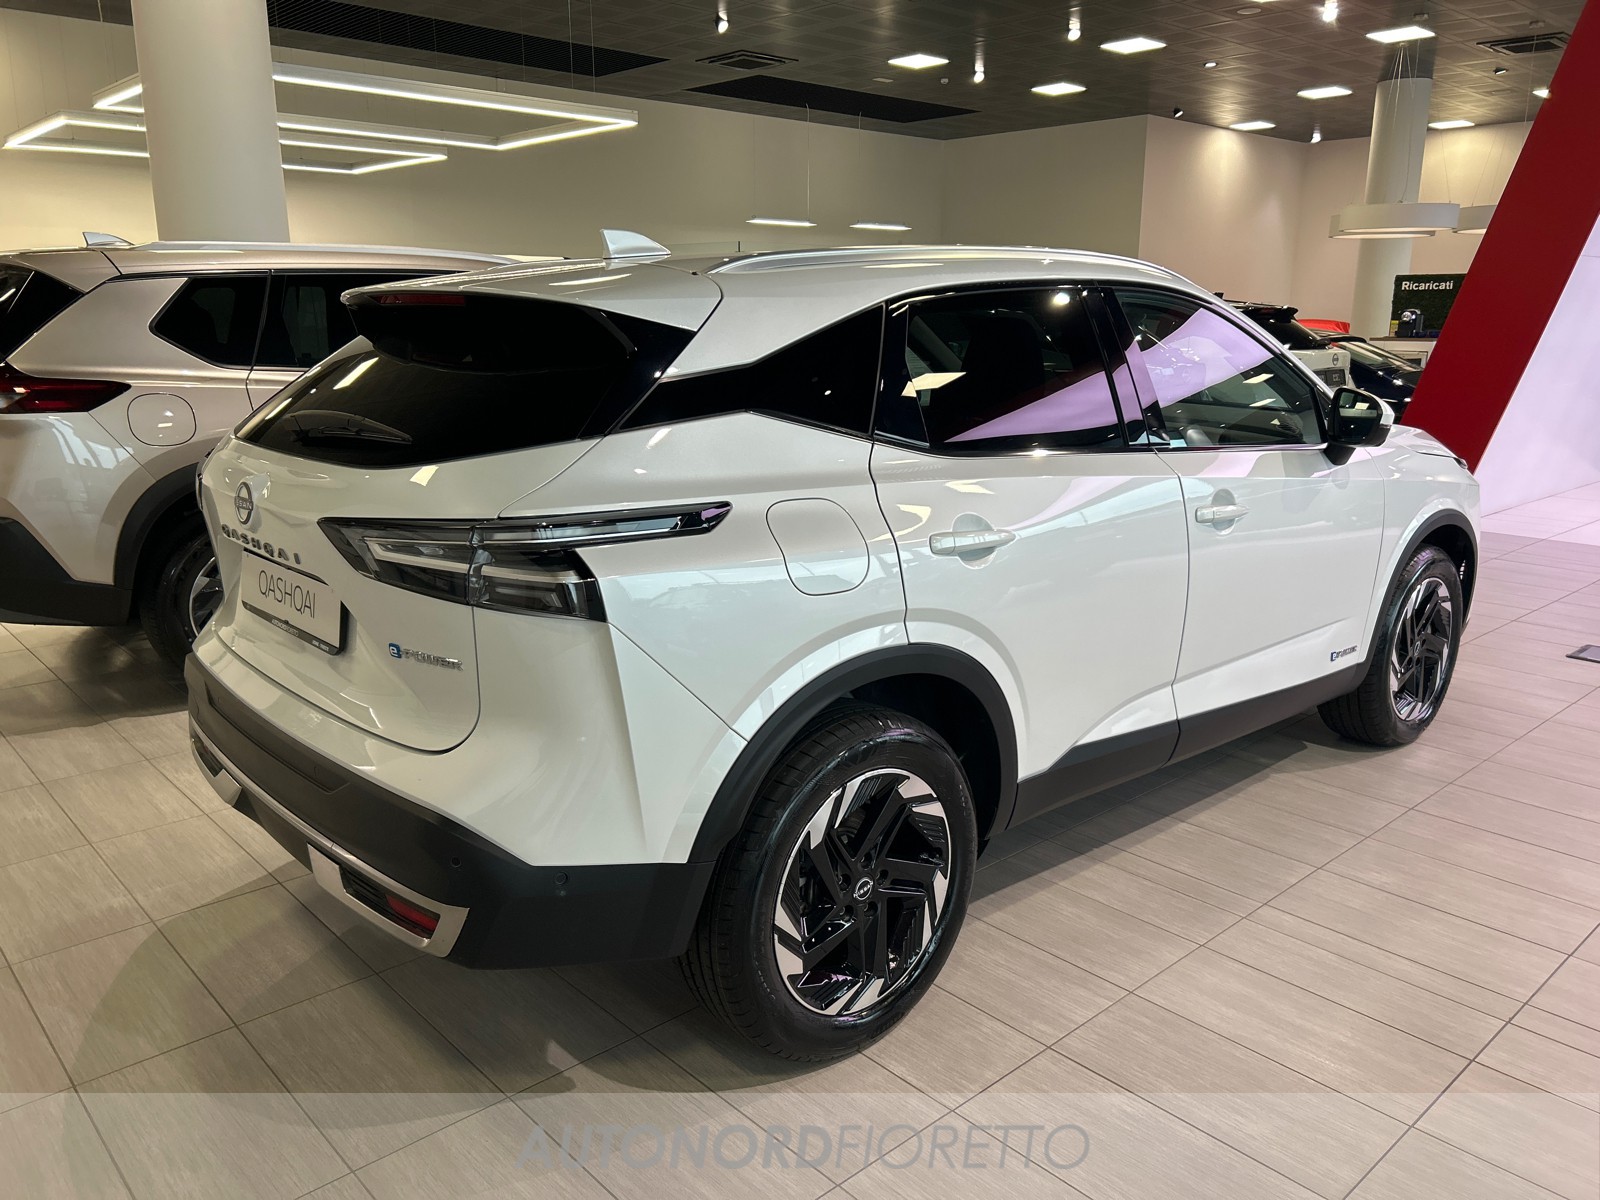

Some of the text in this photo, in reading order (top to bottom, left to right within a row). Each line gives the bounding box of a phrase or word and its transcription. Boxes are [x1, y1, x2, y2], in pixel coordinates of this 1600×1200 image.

[1401, 280, 1454, 290] Ricaricati
[221, 523, 301, 565] QASHQAI
[258, 569, 316, 619] QASHQAI
